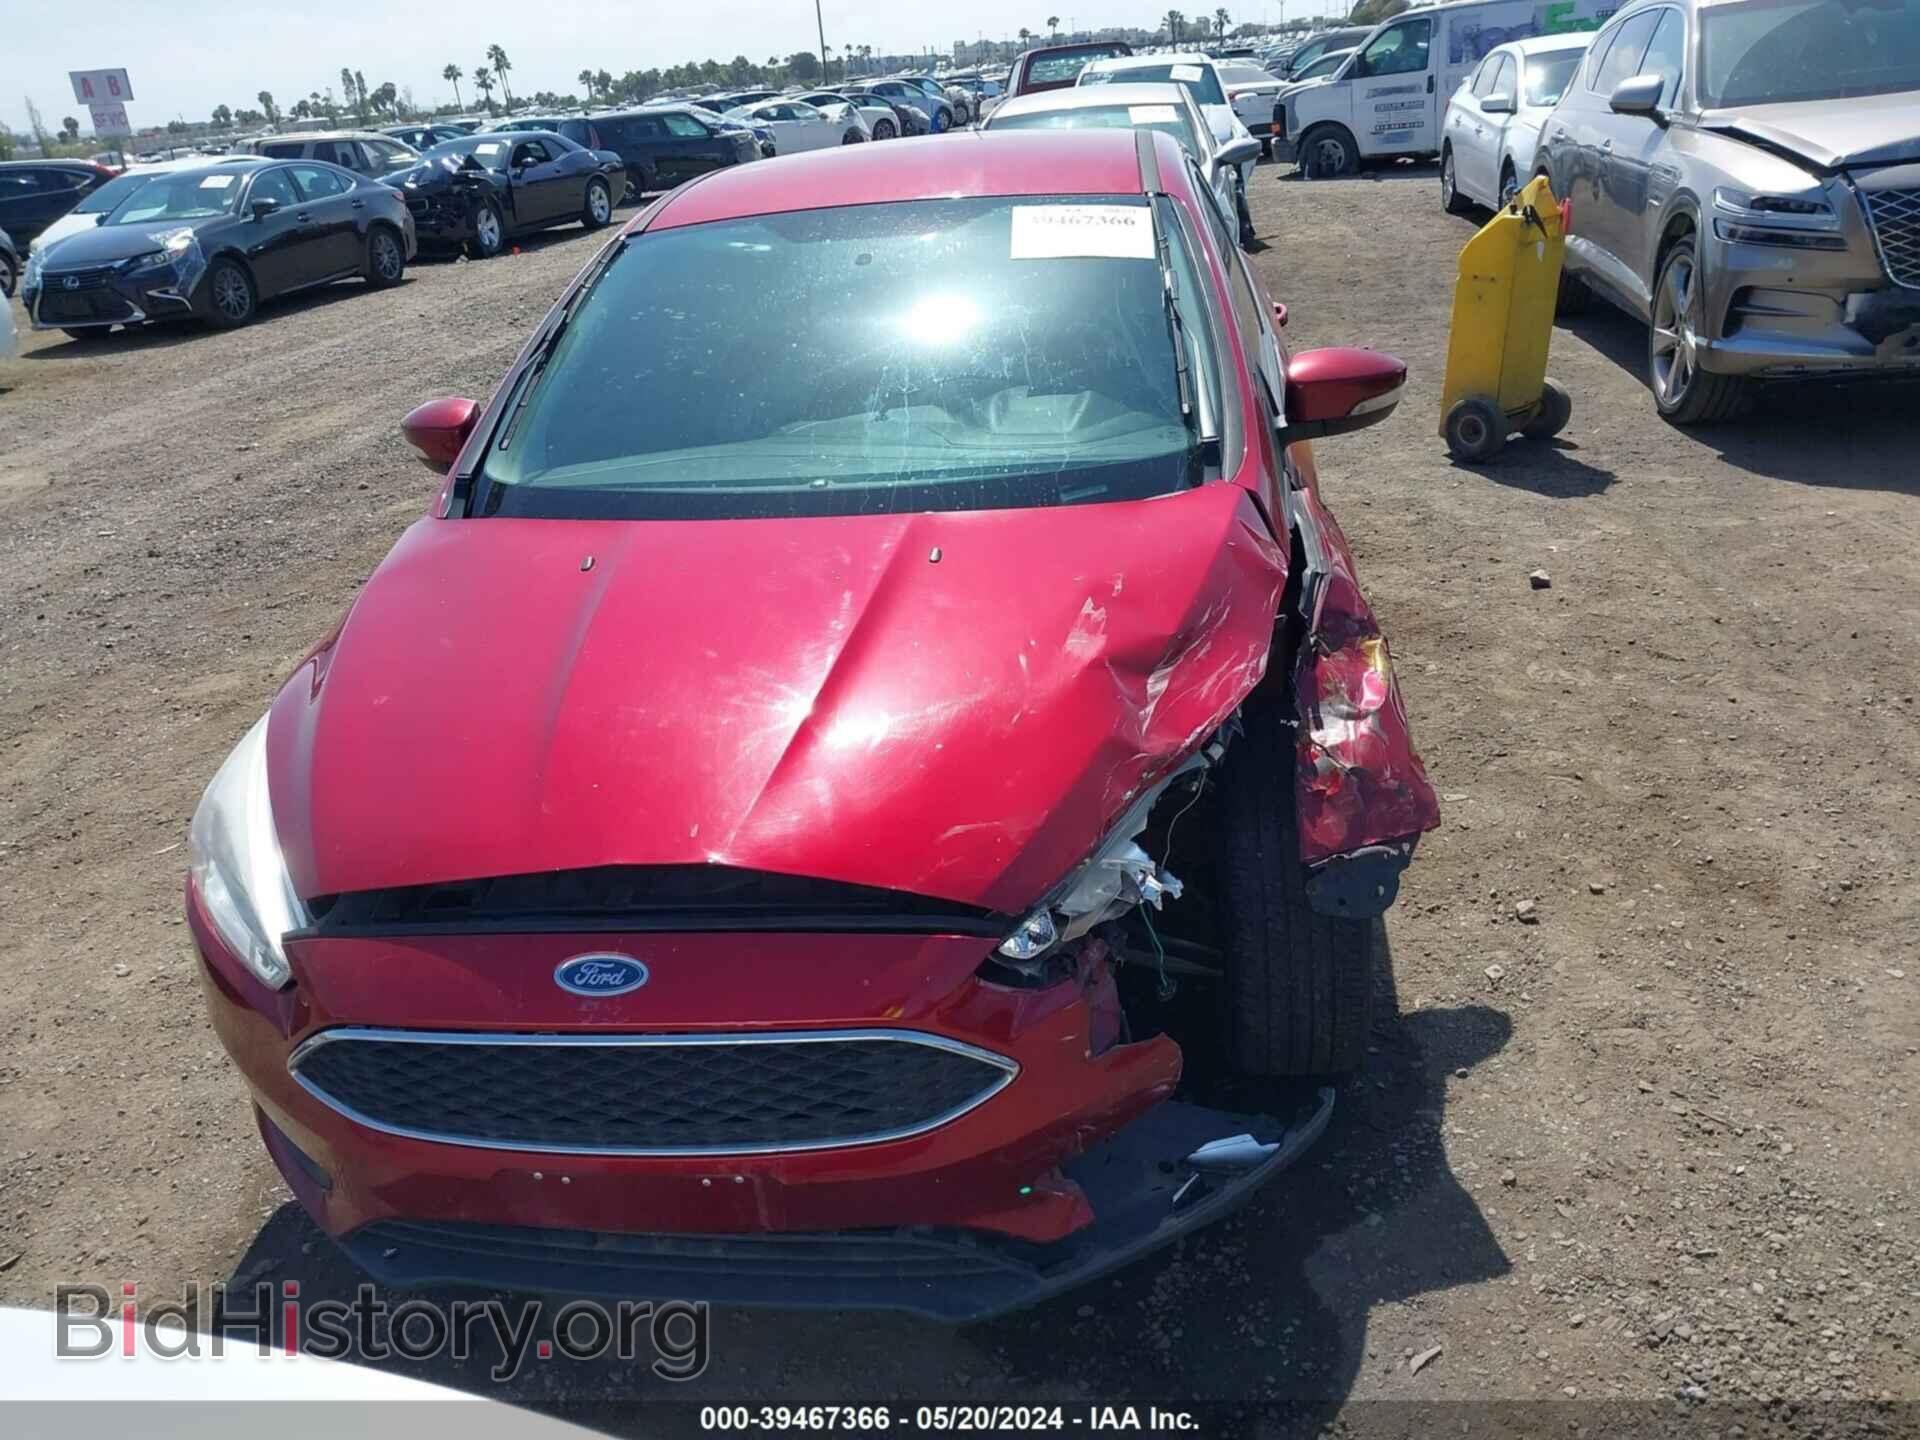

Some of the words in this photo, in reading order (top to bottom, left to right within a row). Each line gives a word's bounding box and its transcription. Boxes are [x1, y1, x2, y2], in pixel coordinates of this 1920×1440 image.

[81, 76, 96, 98] A
[105, 75, 121, 97] B
[1031, 215, 1136, 226] 467366
[574, 962, 627, 985] Ford
